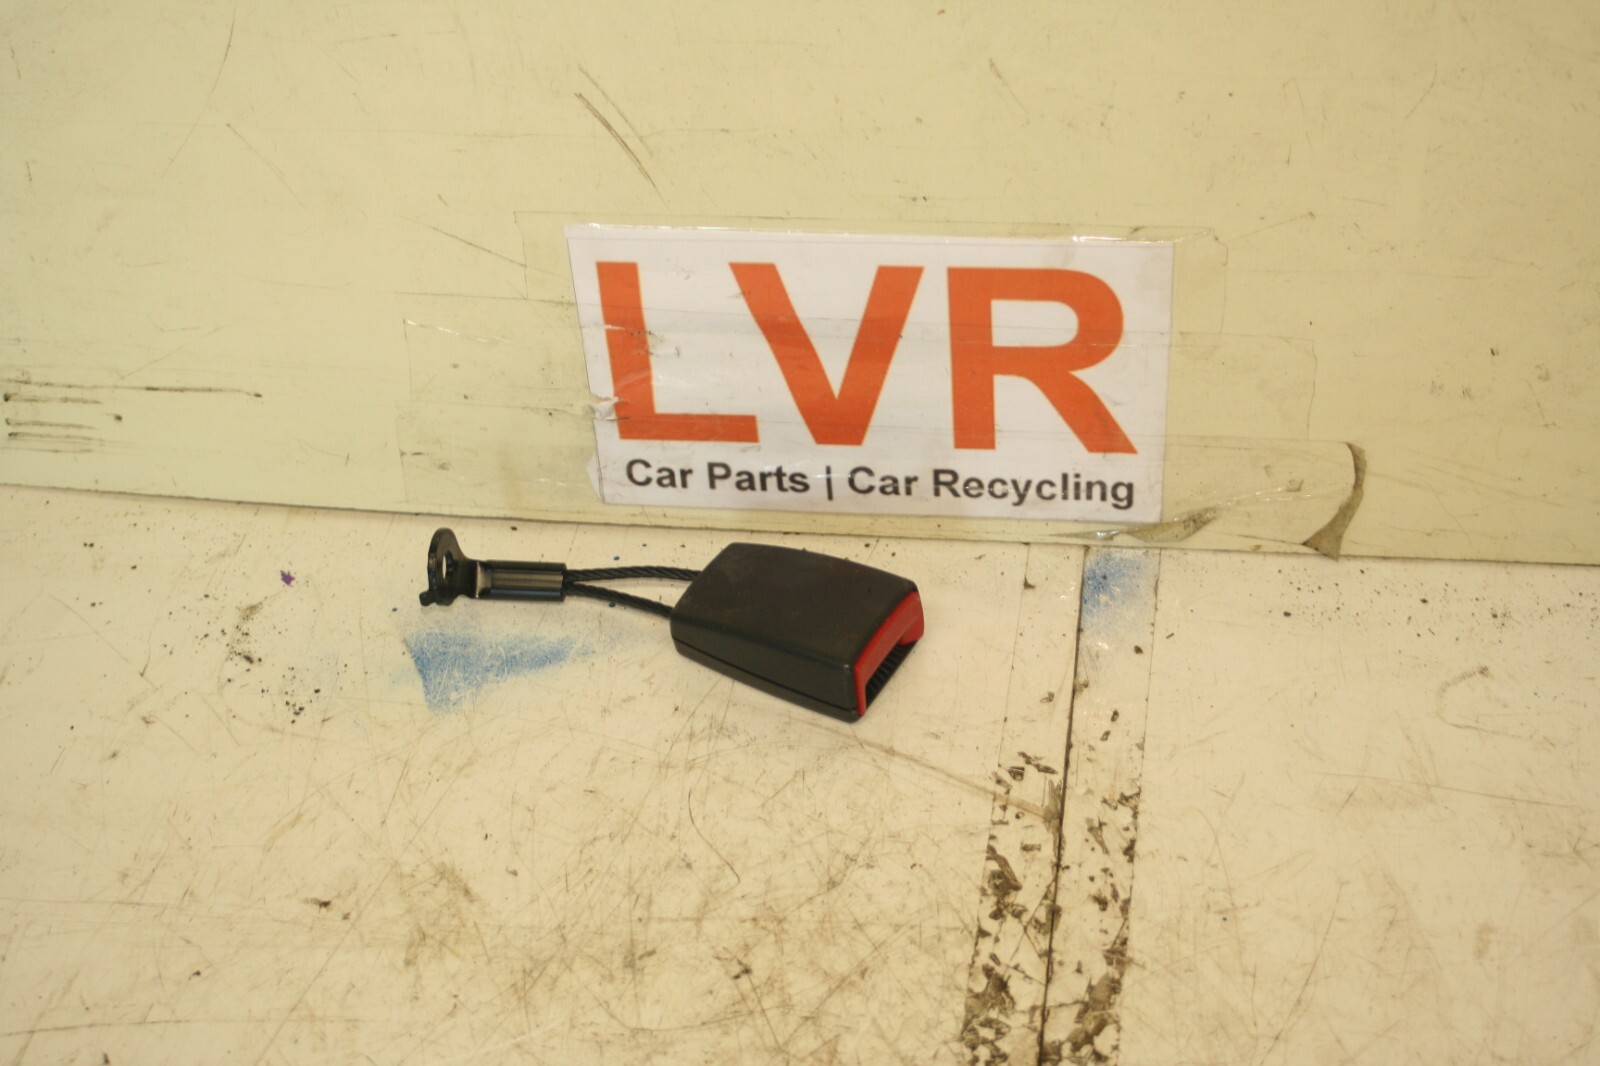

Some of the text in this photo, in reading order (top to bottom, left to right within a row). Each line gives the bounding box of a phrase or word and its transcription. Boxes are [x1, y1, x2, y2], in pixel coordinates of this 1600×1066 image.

[595, 260, 1138, 455] LVR
[626, 458, 693, 489] Car
[707, 461, 811, 493] Parts
[847, 465, 919, 497] Car
[932, 468, 1135, 509] Recycling
